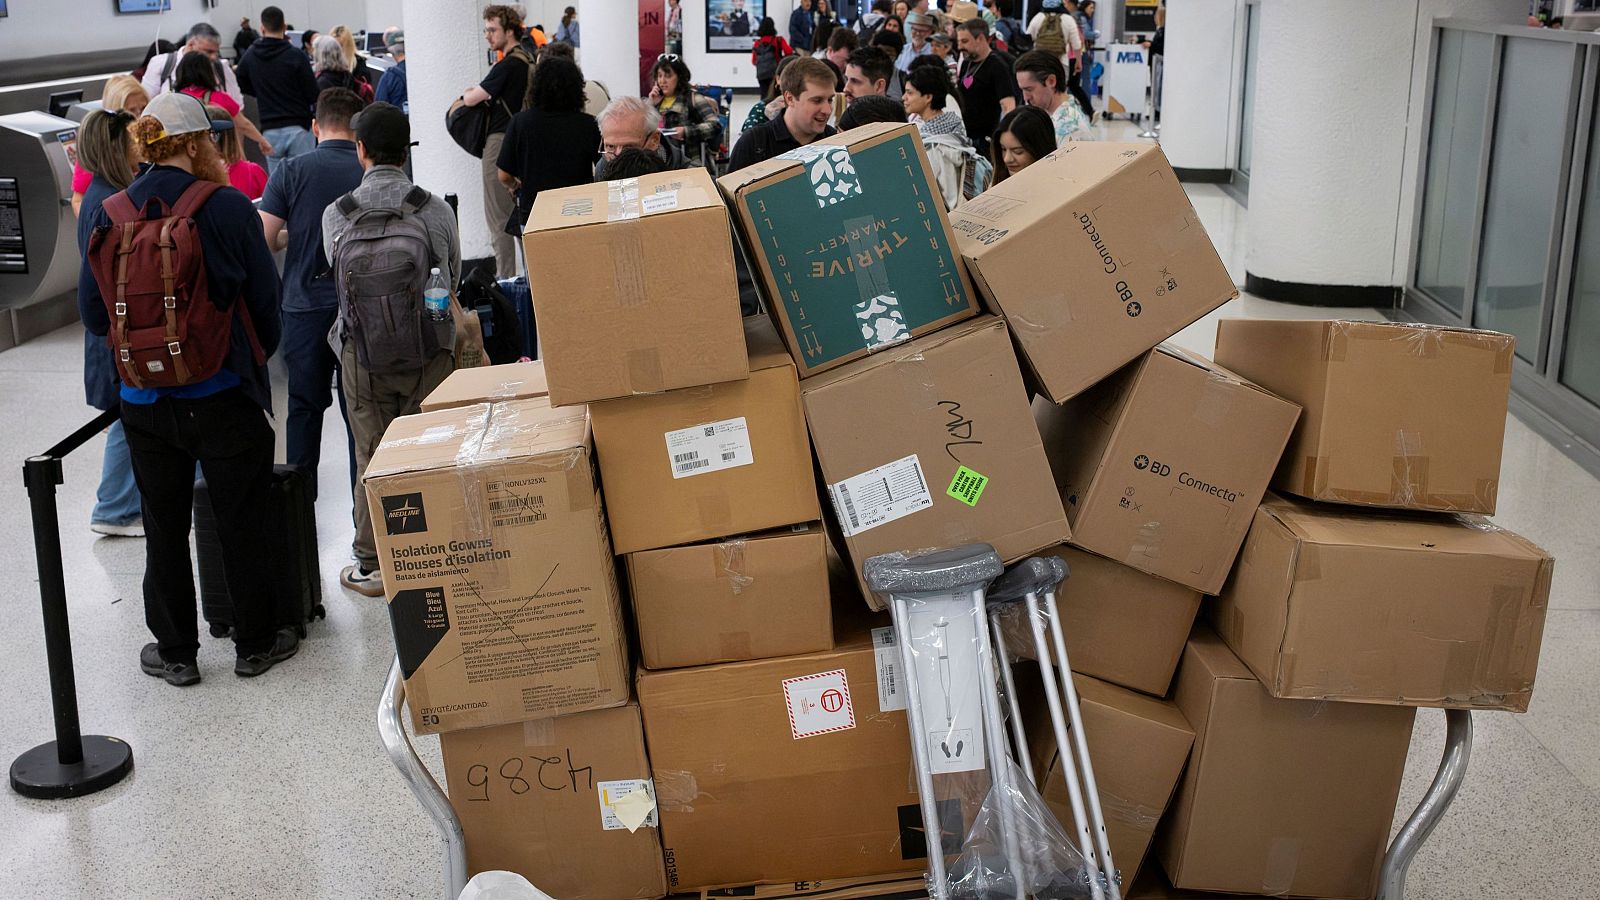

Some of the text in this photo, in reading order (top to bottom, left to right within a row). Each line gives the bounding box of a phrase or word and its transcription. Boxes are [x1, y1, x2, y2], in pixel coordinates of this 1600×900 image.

[898, 147, 946, 268] FRAGILE
[819, 219, 888, 254] MARKET
[758, 199, 806, 321] FRAGILE
[811, 231, 909, 278] THRIVE
[1115, 279, 1133, 302] BD
[1150, 461, 1171, 477] BD
[951, 470, 966, 493] OVER PACK
[388, 508, 420, 519] MEDLINE
[391, 538, 493, 558] Isolation Gowns
[393, 557, 443, 572] Blouses
[395, 567, 469, 581] Batas de aislamiento
[425, 591, 440, 599] Blue
[427, 605, 443, 613] Azul
[422, 714, 440, 725] 50
